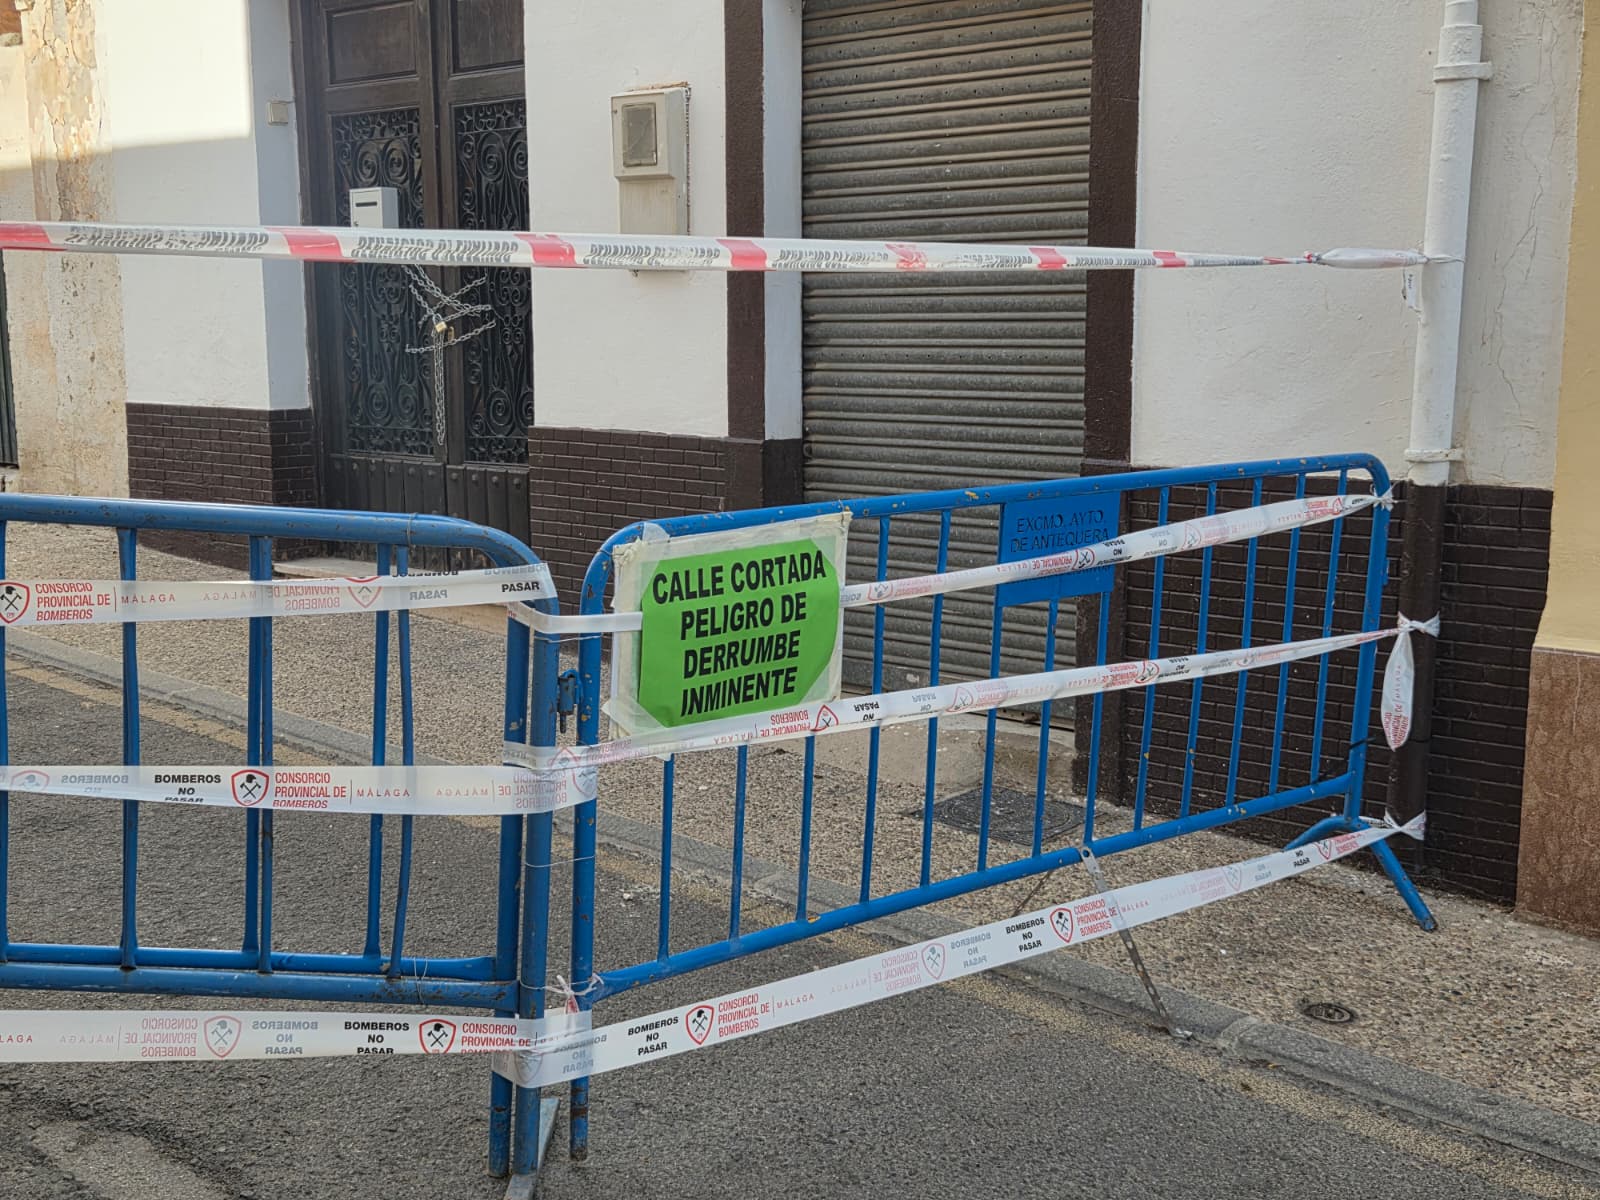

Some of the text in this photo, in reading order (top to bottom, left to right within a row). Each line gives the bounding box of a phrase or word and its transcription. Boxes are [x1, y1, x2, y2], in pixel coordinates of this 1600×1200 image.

[1010, 528, 1109, 552] DE ANTEQUERA
[652, 550, 826, 604] CALLE CORTADA
[35, 582, 93, 594] CONSORCIO
[501, 581, 540, 593] PASAR
[37, 593, 111, 608] PROVINCIAL DE
[36, 609, 93, 621] BOMBEROS
[680, 592, 807, 640] PELIGRO DE
[684, 631, 800, 679] DERRUMBE
[680, 667, 798, 717] INMINENTE
[854, 702, 880, 712] PASAR
[770, 709, 809, 725] BOMBEROS
[154, 774, 222, 784] BOMBEROS
[275, 773, 330, 784] CONSORCIO
[178, 787, 195, 795] NO
[275, 786, 346, 798] PROVINCIAL DE
[272, 800, 328, 809] BOMBEROS
[1074, 899, 1105, 915] CONSORCIO
[1077, 907, 1118, 926] PROVINCIAL DE
[1005, 917, 1045, 934] BOMBEROS
[1080, 920, 1112, 937] BOMBEROS
[1022, 931, 1033, 940] NO
[1018, 940, 1042, 953] PASAR
[718, 993, 759, 1012] CONSORCIO
[718, 1002, 769, 1025] PROVINCIAL DE
[344, 1021, 409, 1031] BOMBEROS
[462, 1022, 517, 1035] CONSORCIO
[628, 1016, 679, 1036] BOMBEROS
[718, 1018, 759, 1037] BOMBEROS
[367, 1035, 384, 1043] NO
[461, 1035, 517, 1048] PROVINCIAL
[646, 1032, 659, 1042] NO
[637, 1041, 668, 1056] PASAR
